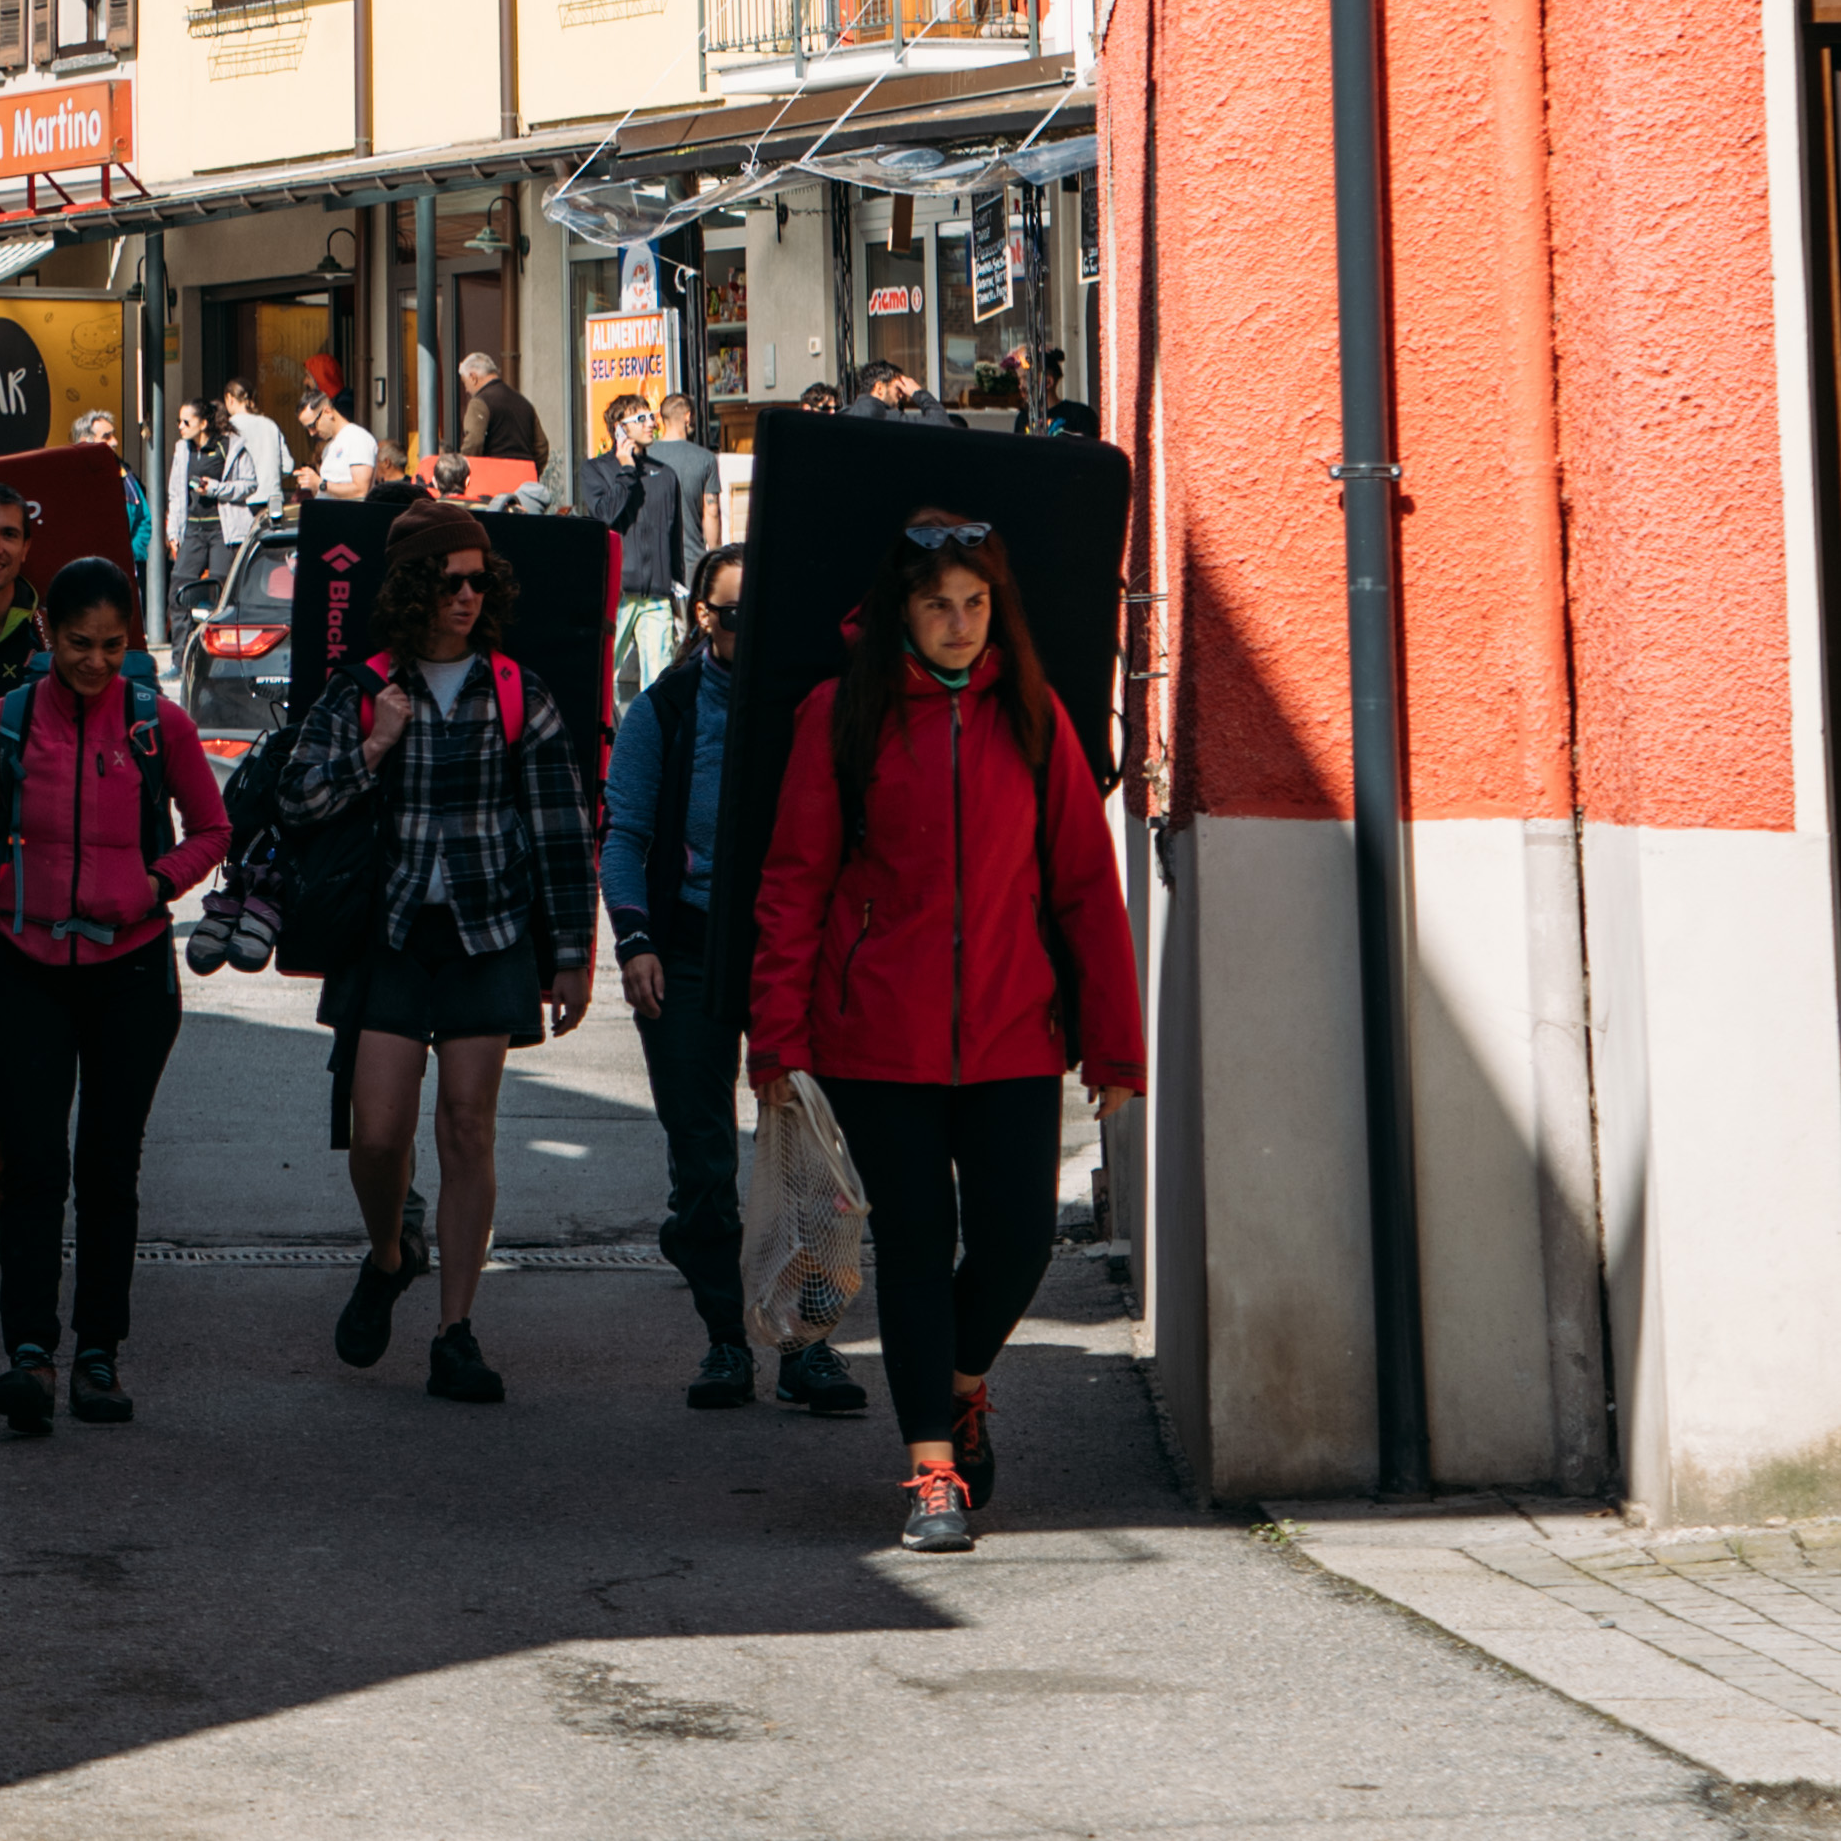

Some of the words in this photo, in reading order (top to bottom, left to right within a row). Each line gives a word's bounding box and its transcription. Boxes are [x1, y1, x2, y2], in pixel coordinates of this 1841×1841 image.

[13, 97, 102, 158] Martino
[592, 318, 664, 352] ALIMENTARI
[592, 359, 616, 379] SELF
[619, 354, 662, 377] SERVICE
[326, 580, 351, 661] Black
